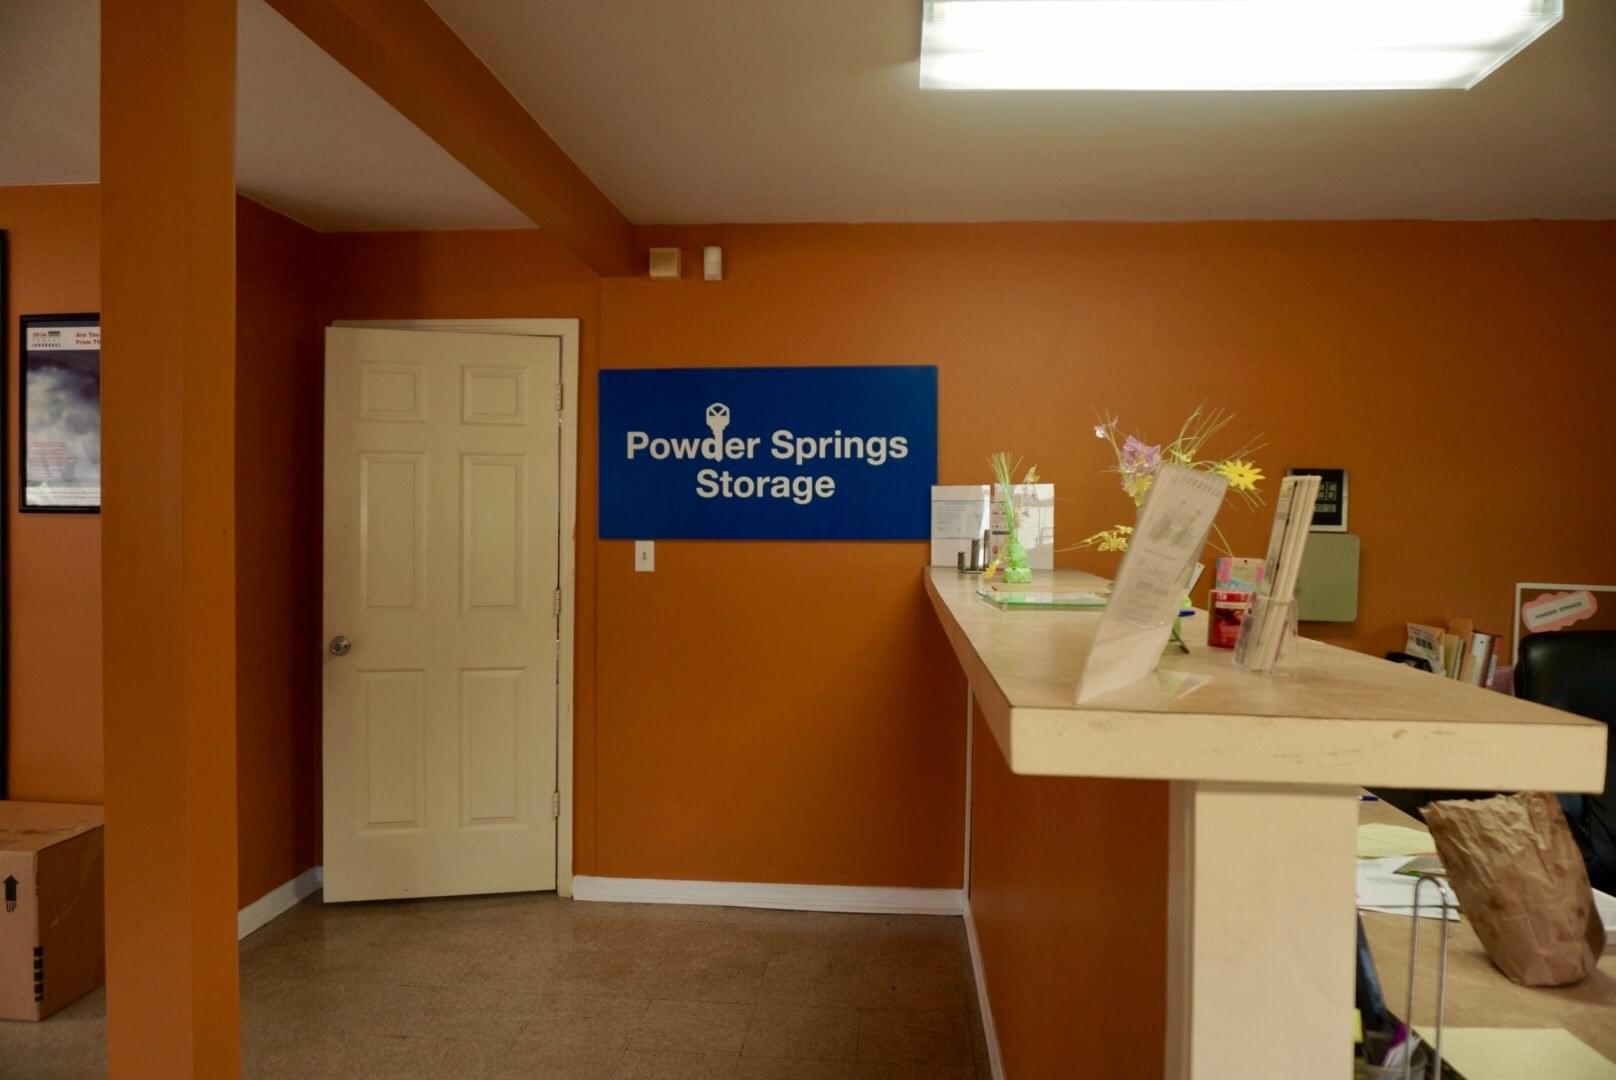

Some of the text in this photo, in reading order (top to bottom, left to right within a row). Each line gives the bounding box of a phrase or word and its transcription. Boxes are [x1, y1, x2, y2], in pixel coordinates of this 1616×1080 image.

[626, 402, 909, 465] Powder Springs
[696, 468, 836, 505] Storage
[6, 902, 17, 912] UP
